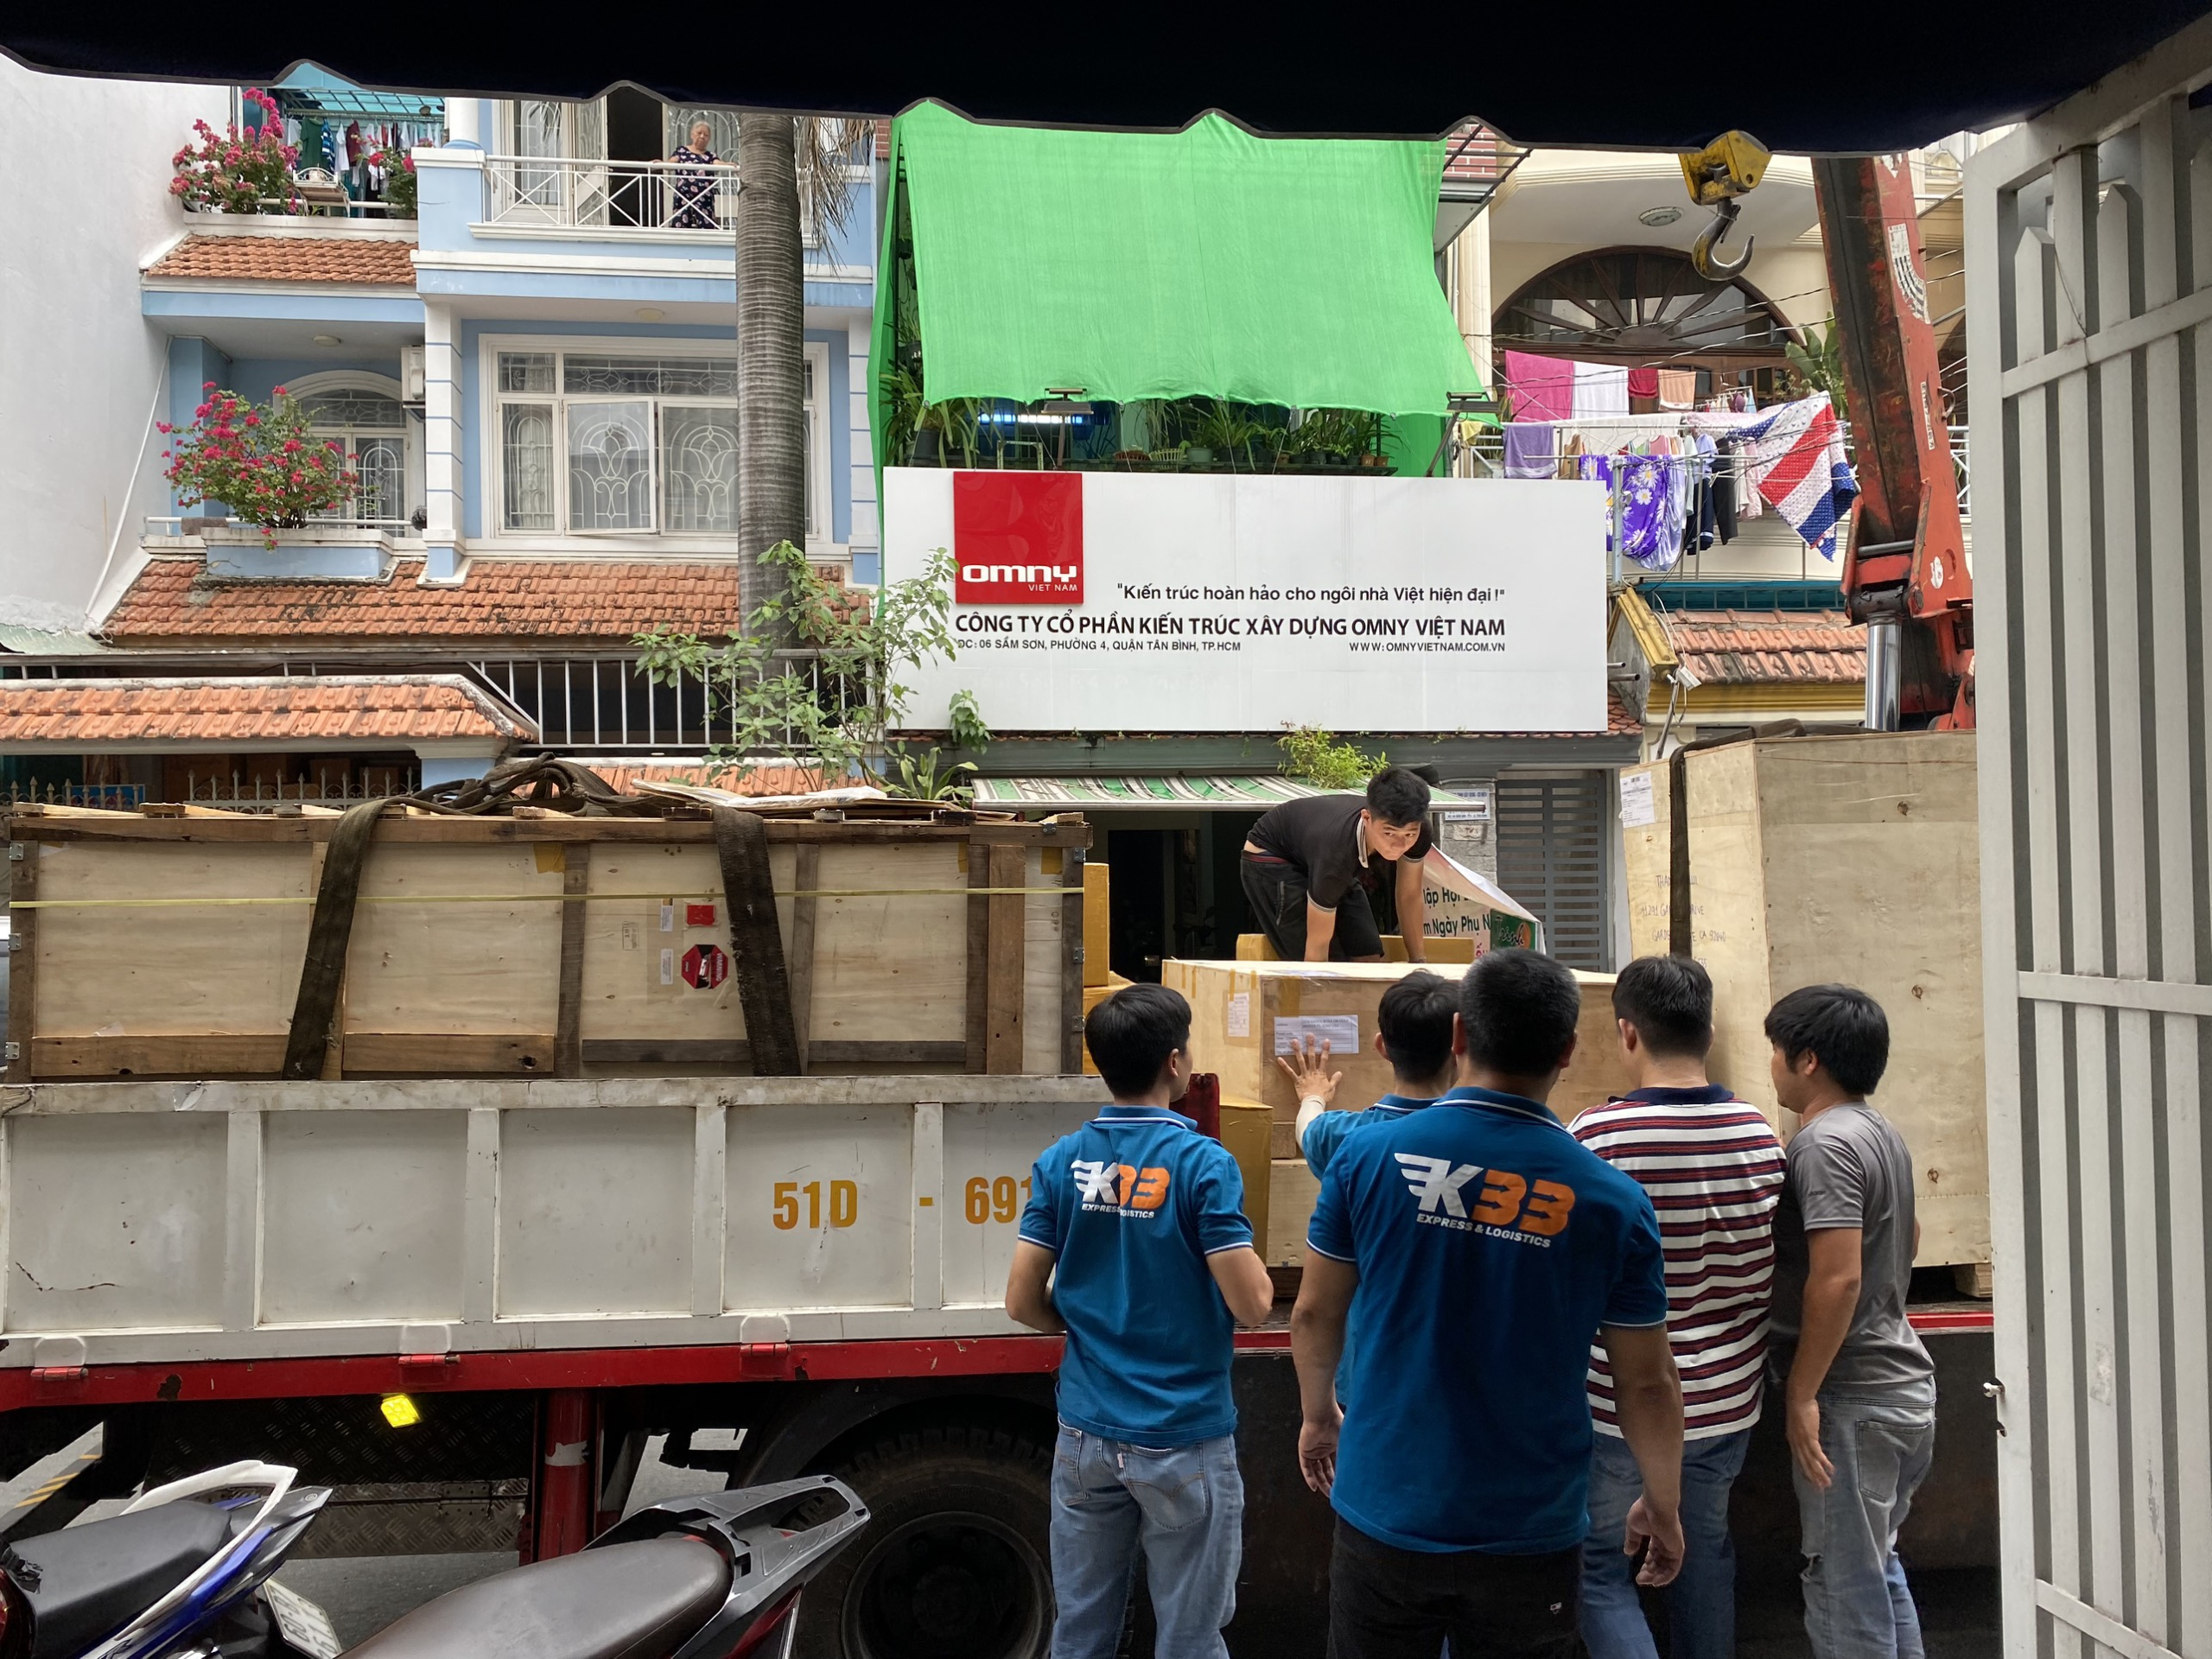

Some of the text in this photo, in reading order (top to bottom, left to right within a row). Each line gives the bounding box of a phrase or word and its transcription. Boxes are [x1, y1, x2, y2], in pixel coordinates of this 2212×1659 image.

[1166, 584, 1199, 600] trúc
[1204, 583, 1245, 601] hoàn
[1249, 584, 1280, 601] hảo
[1285, 587, 1316, 601] cho
[1320, 586, 1356, 604] ngôi
[1359, 587, 1389, 601] nhà
[1393, 587, 1425, 604] Việt
[1429, 588, 1464, 604] hiện
[955, 609, 1505, 639] CÔNG TY CỔ PHẦN KIẾN TRÚC XÂY DỰNG OMNY VIỆT NAM
[979, 639, 992, 649] 06
[1022, 639, 1047, 651] SƠN,
[1050, 637, 1096, 651] PHƯỜNG
[1100, 639, 1110, 652] 4,
[1112, 639, 1143, 652] QUẬN
[1146, 638, 1169, 651] TÂN
[1172, 638, 1199, 652] BÌNH,
[1201, 641, 1242, 652] TP.HCM
[1433, 916, 1459, 938] Ngày
[1461, 915, 1480, 936] Phụ
[1483, 913, 1491, 931] N
[772, 1179, 858, 1230] 51D
[1416, 1213, 1552, 1249] EXPRESS & LOGISTICS
